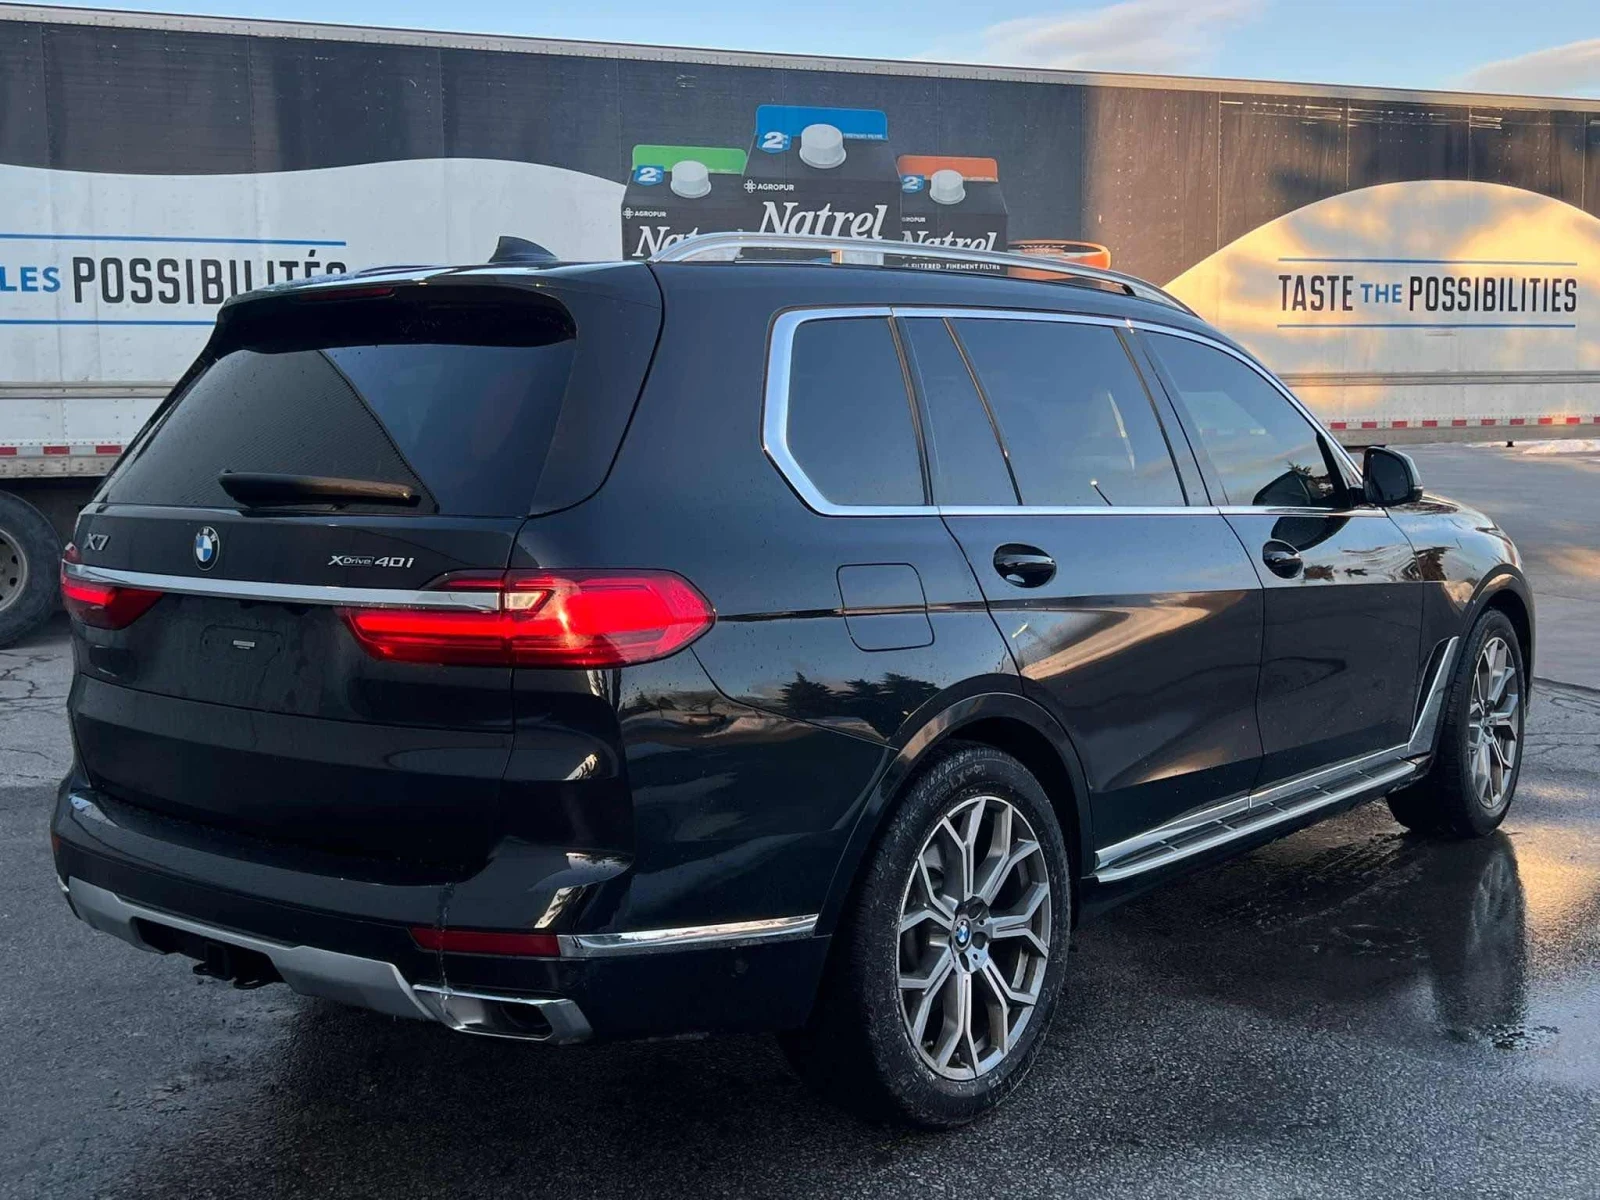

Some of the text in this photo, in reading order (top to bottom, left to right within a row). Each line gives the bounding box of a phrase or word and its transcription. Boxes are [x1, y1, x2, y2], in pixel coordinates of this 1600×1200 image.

[757, 183, 795, 191] AGROPUR
[634, 210, 667, 218] AGROPUR
[760, 201, 888, 239] Natrel
[0, 266, 61, 292] LES
[1278, 275, 1577, 312] TASTE THE POSSIBILITIES
[84, 533, 110, 551] X7
